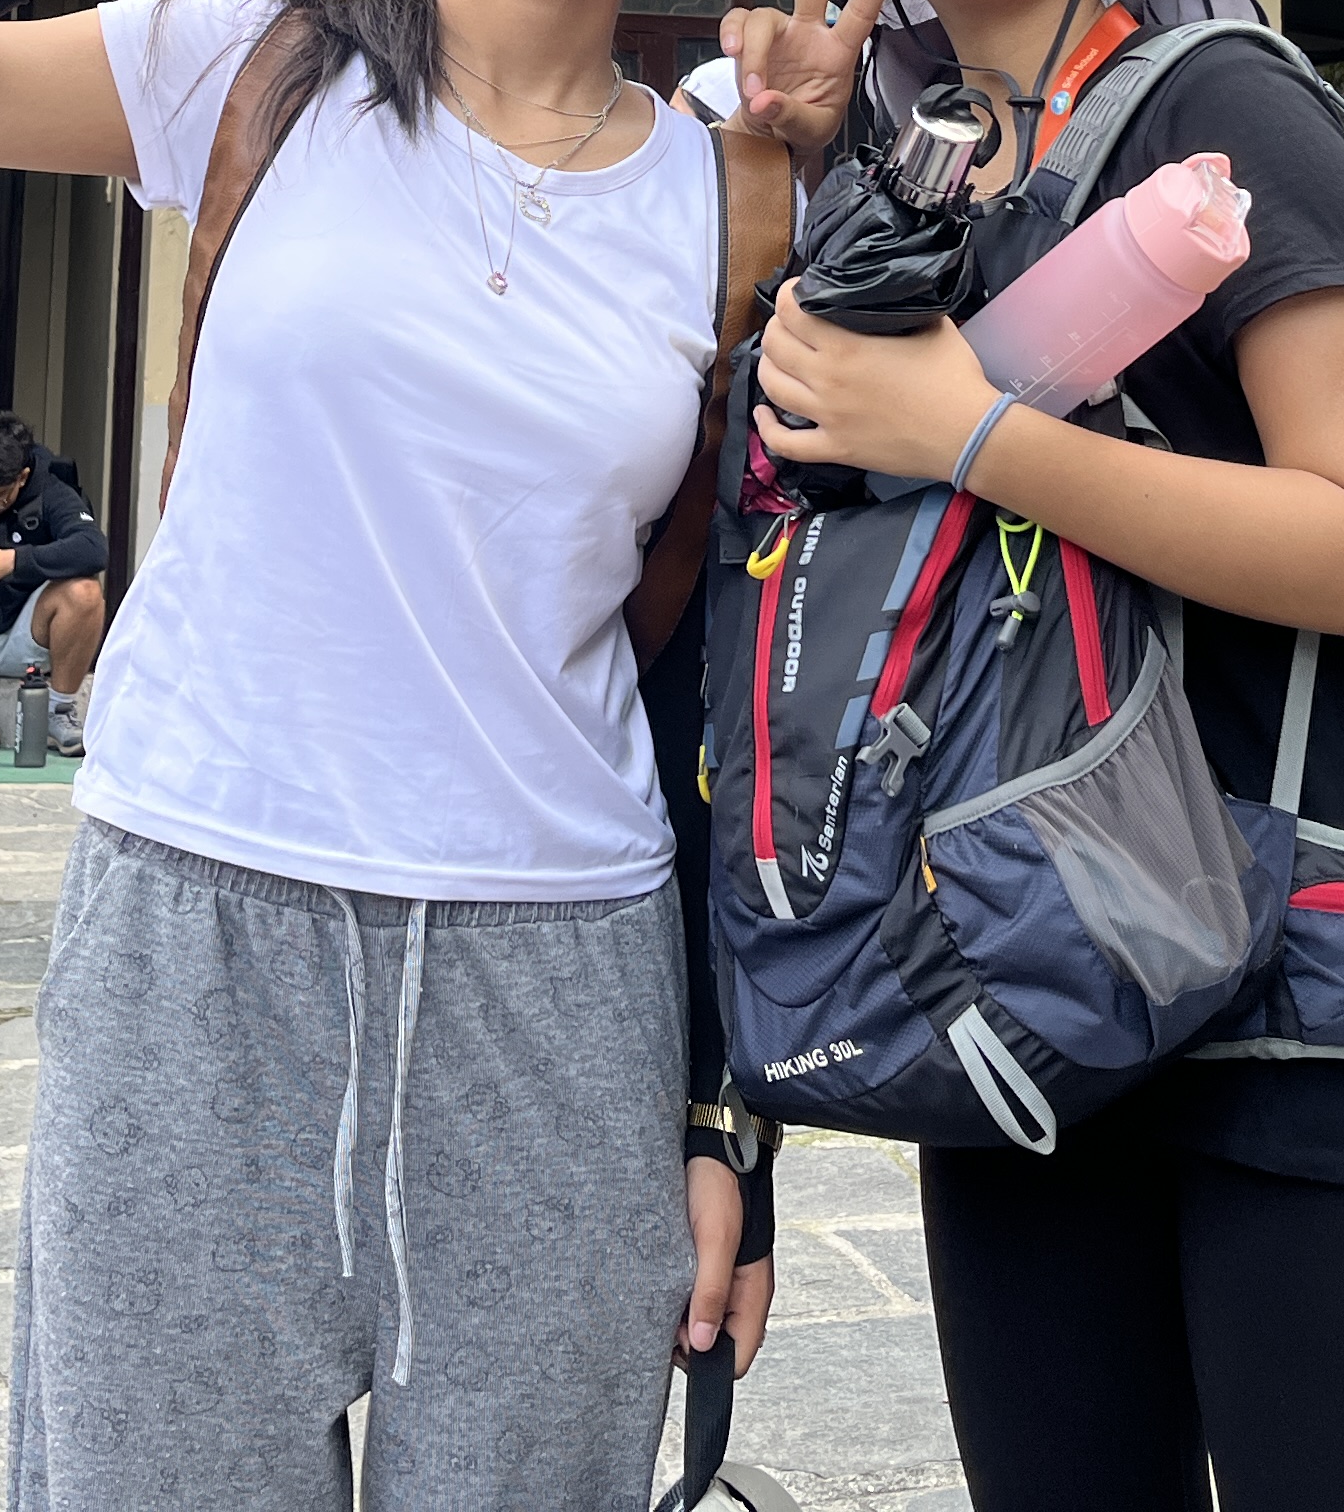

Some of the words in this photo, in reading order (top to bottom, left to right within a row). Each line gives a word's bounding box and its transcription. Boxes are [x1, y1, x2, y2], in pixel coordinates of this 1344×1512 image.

[782, 576, 807, 693] OUTDOOR
[764, 1048, 829, 1083] HIKING
[829, 1039, 864, 1062] 30L
